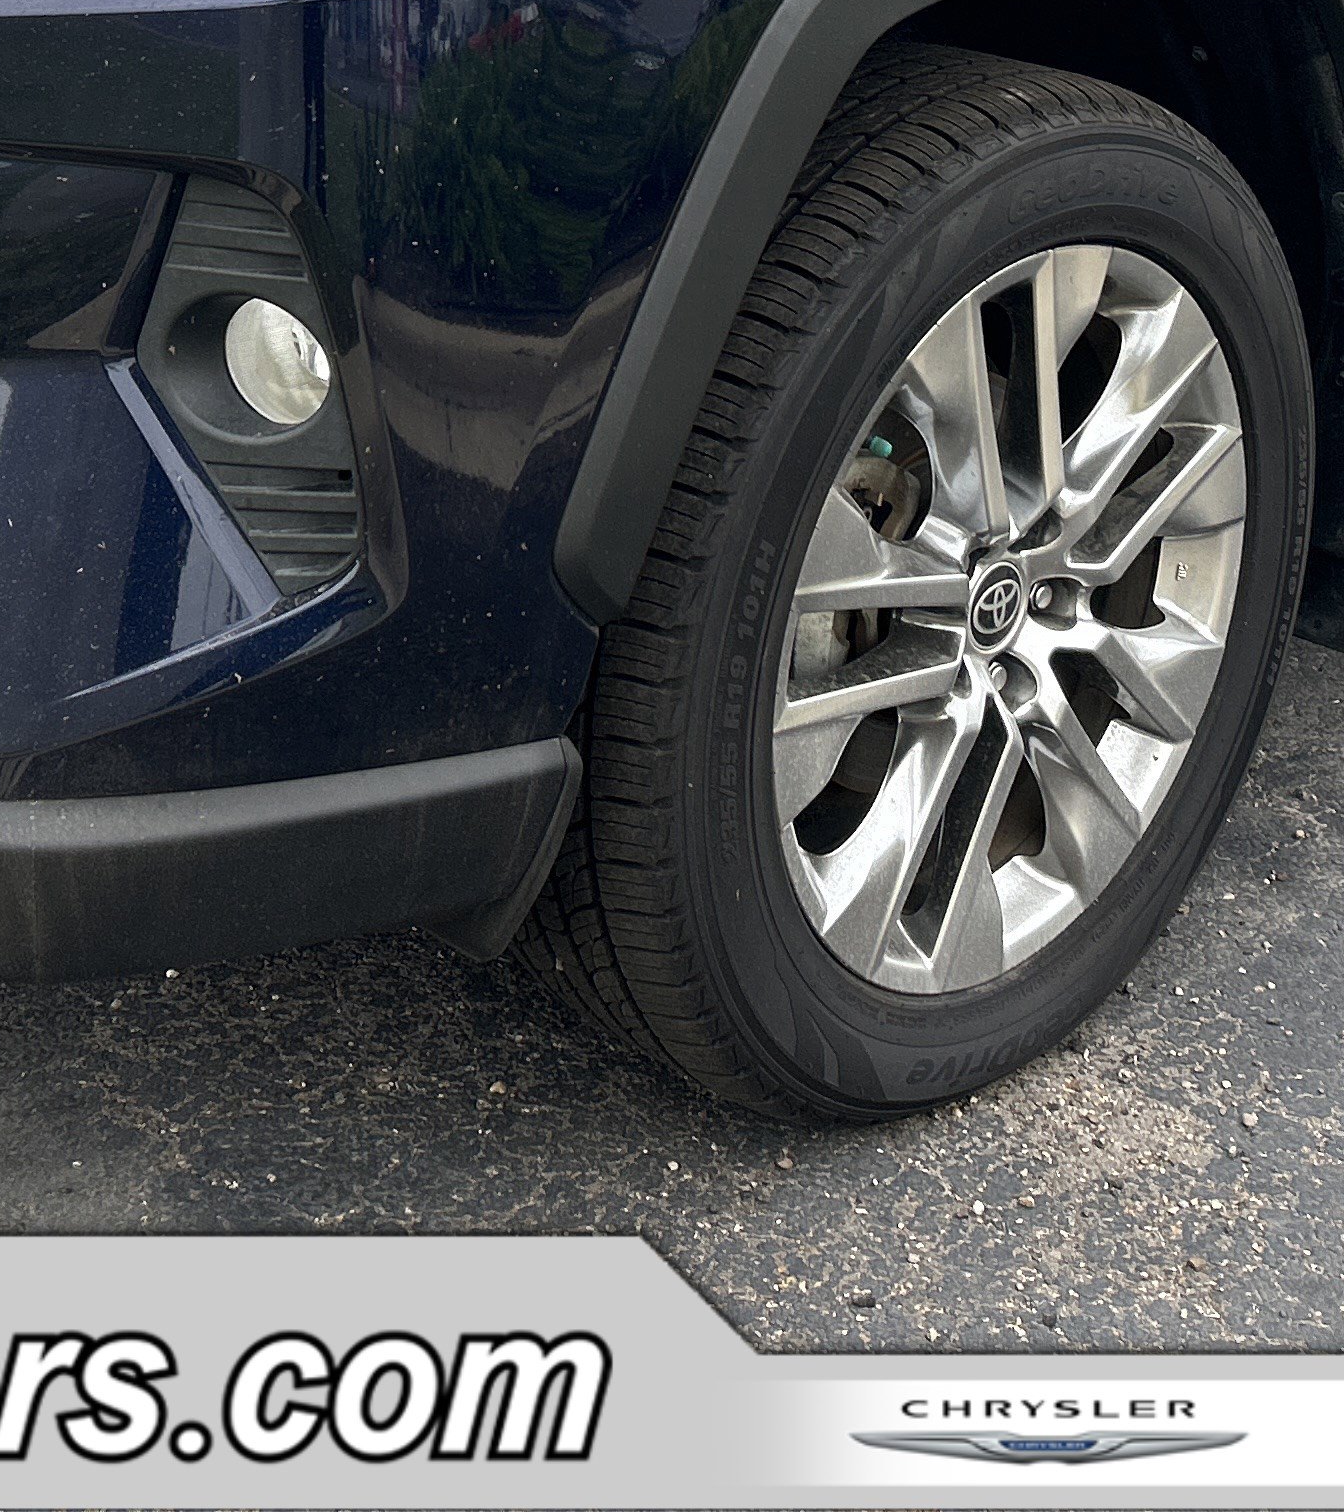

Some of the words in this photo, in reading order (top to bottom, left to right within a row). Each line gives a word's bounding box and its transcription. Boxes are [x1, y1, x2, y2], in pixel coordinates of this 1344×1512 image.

[735, 538, 777, 641] 101H
[723, 654, 749, 730] R19
[718, 742, 741, 866] 235/55
